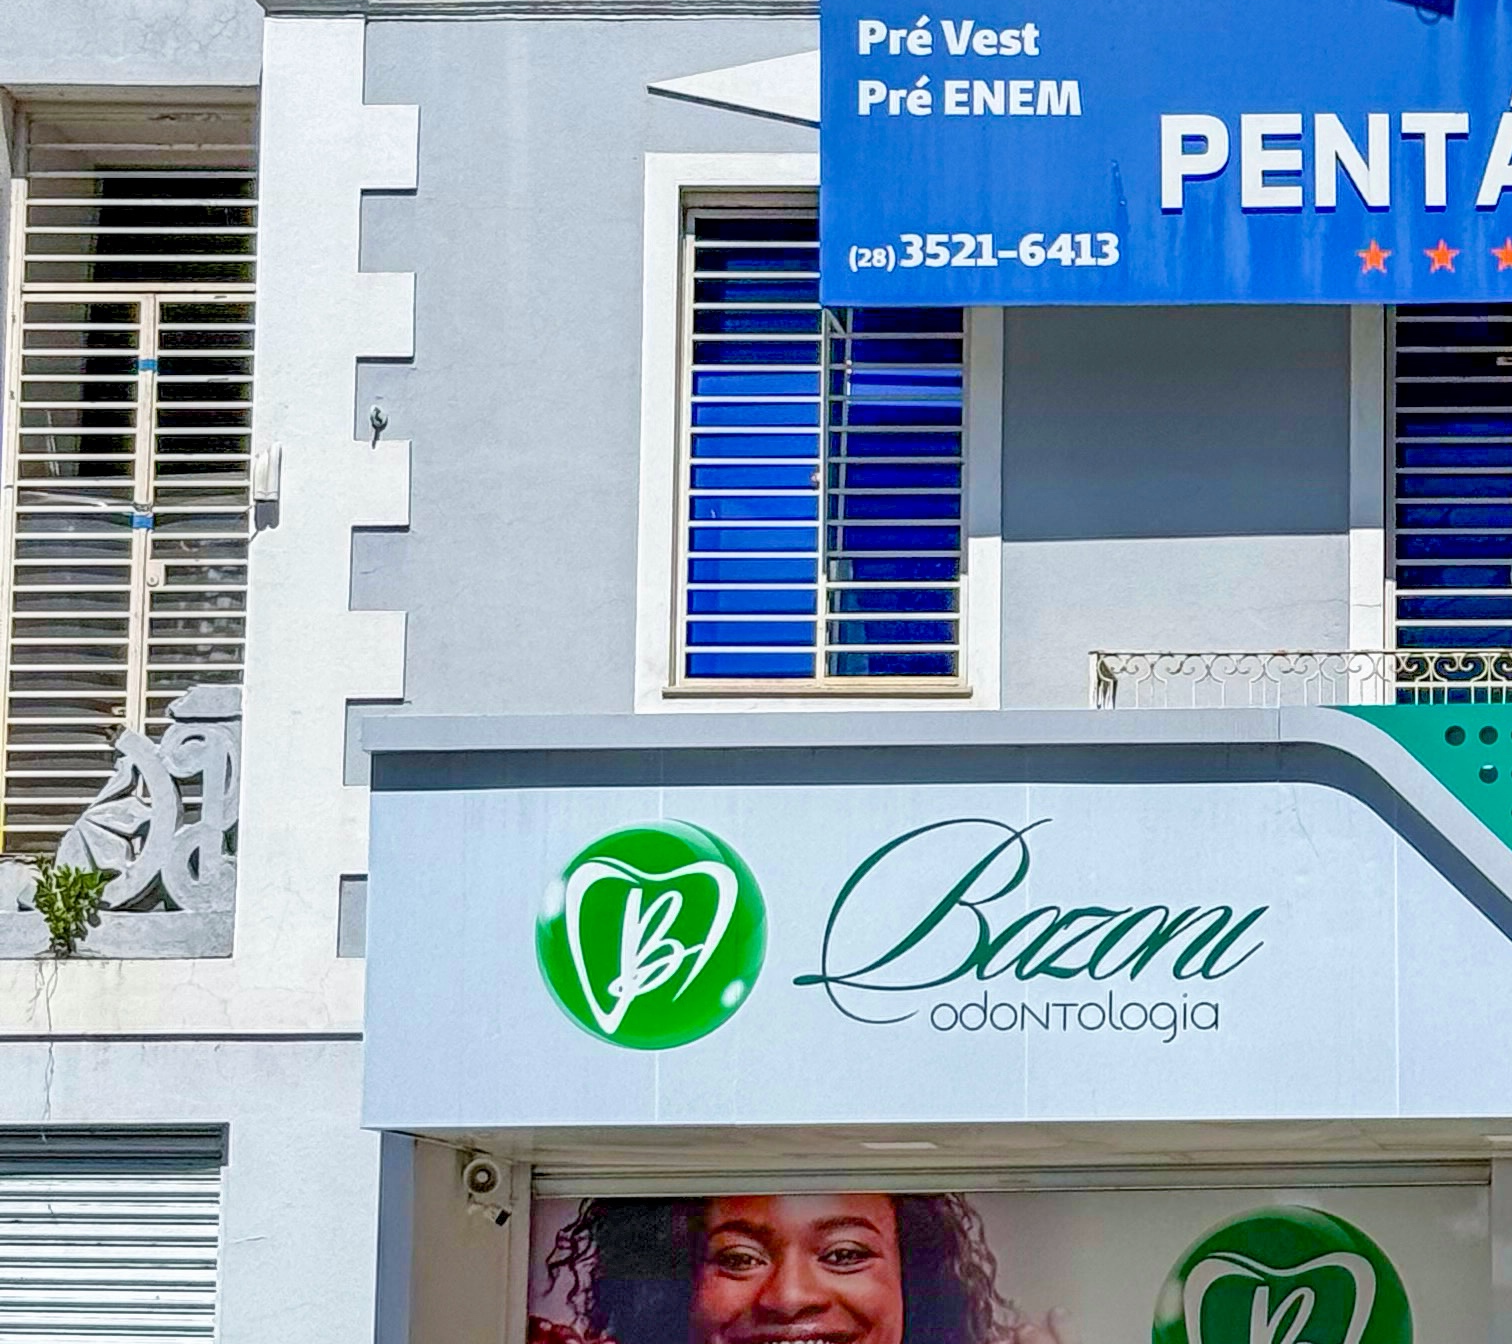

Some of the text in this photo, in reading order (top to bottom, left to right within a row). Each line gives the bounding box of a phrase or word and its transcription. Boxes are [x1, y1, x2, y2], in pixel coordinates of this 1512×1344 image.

[857, 15, 1040, 56] Pré Vest
[857, 78, 1082, 116] Pré ENEM
[848, 233, 1120, 272] (28) 3521-6413
[793, 817, 1270, 1024] Bazoni
